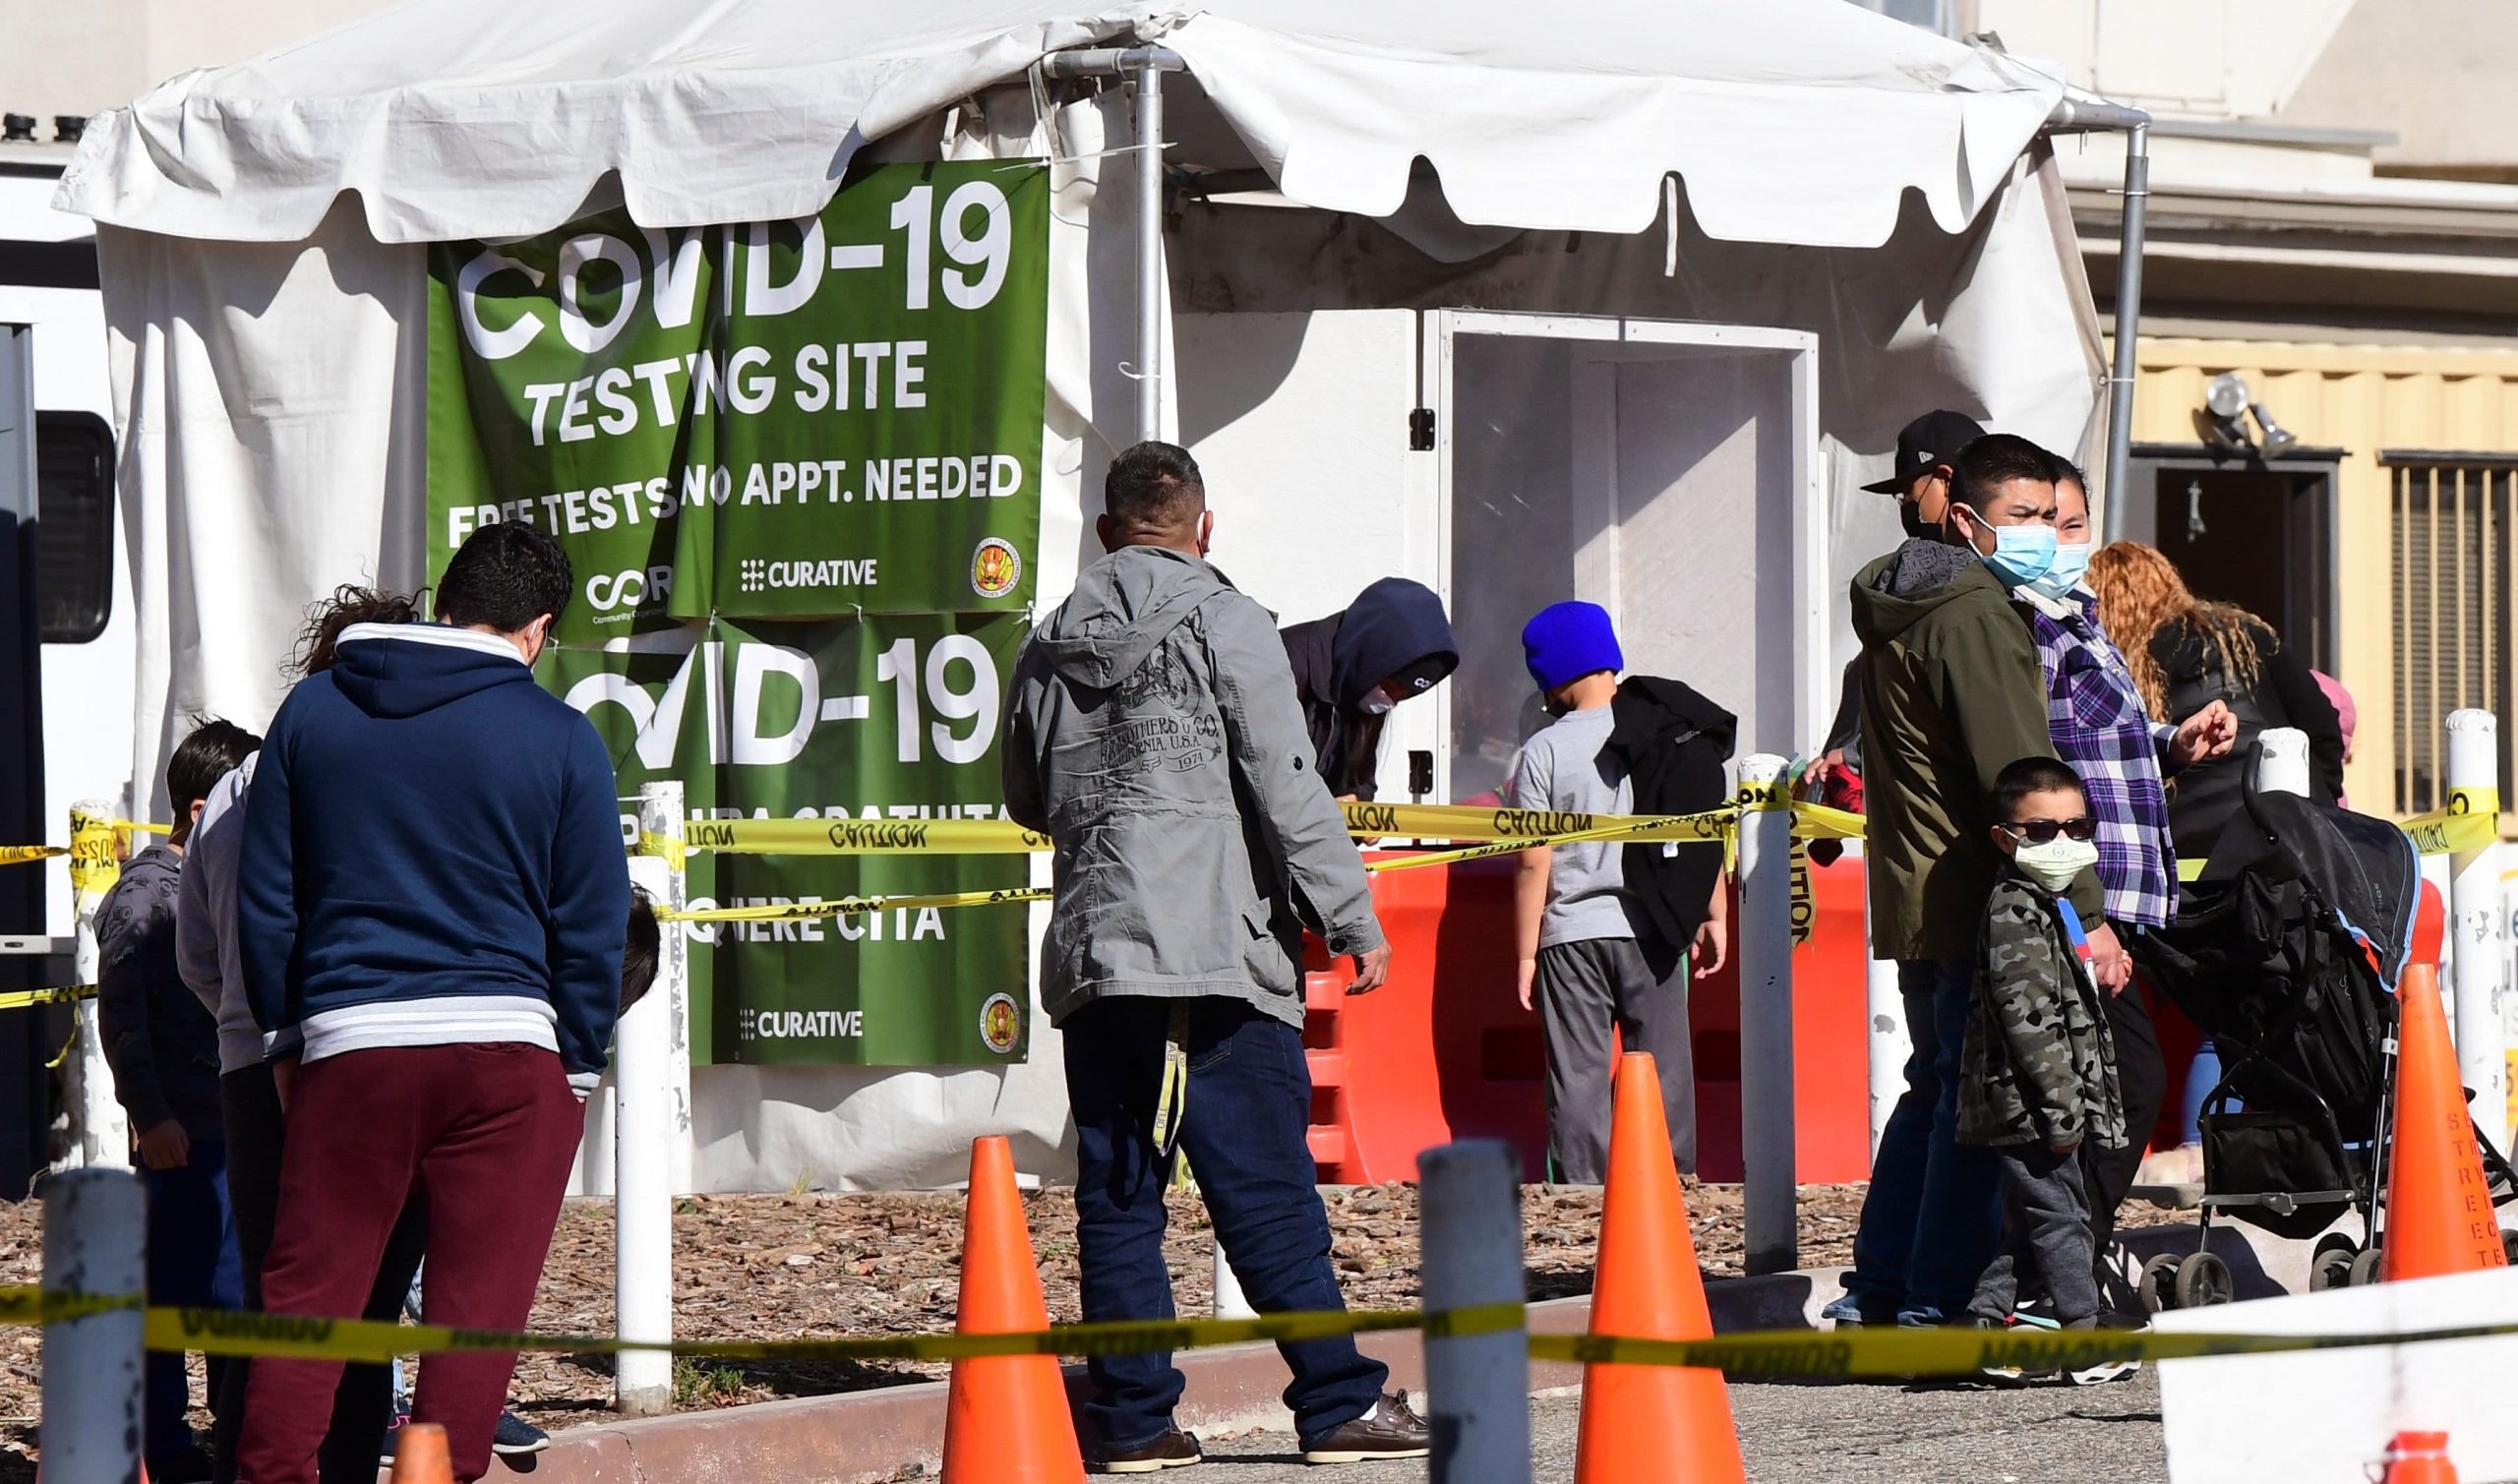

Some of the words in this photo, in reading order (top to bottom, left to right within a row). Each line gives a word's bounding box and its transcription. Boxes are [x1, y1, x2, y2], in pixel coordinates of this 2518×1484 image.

[457, 180, 1012, 360] COVID-19
[794, 340, 929, 412] SITE
[541, 477, 678, 536] TESTS
[681, 464, 732, 506] NO
[741, 459, 853, 505] APPT.
[865, 454, 1022, 502] NEEDED
[586, 564, 673, 611] COR
[768, 559, 877, 588] CURATIVE
[564, 634, 1000, 770] OVID-19
[757, 1011, 864, 1039] CURATIVE
